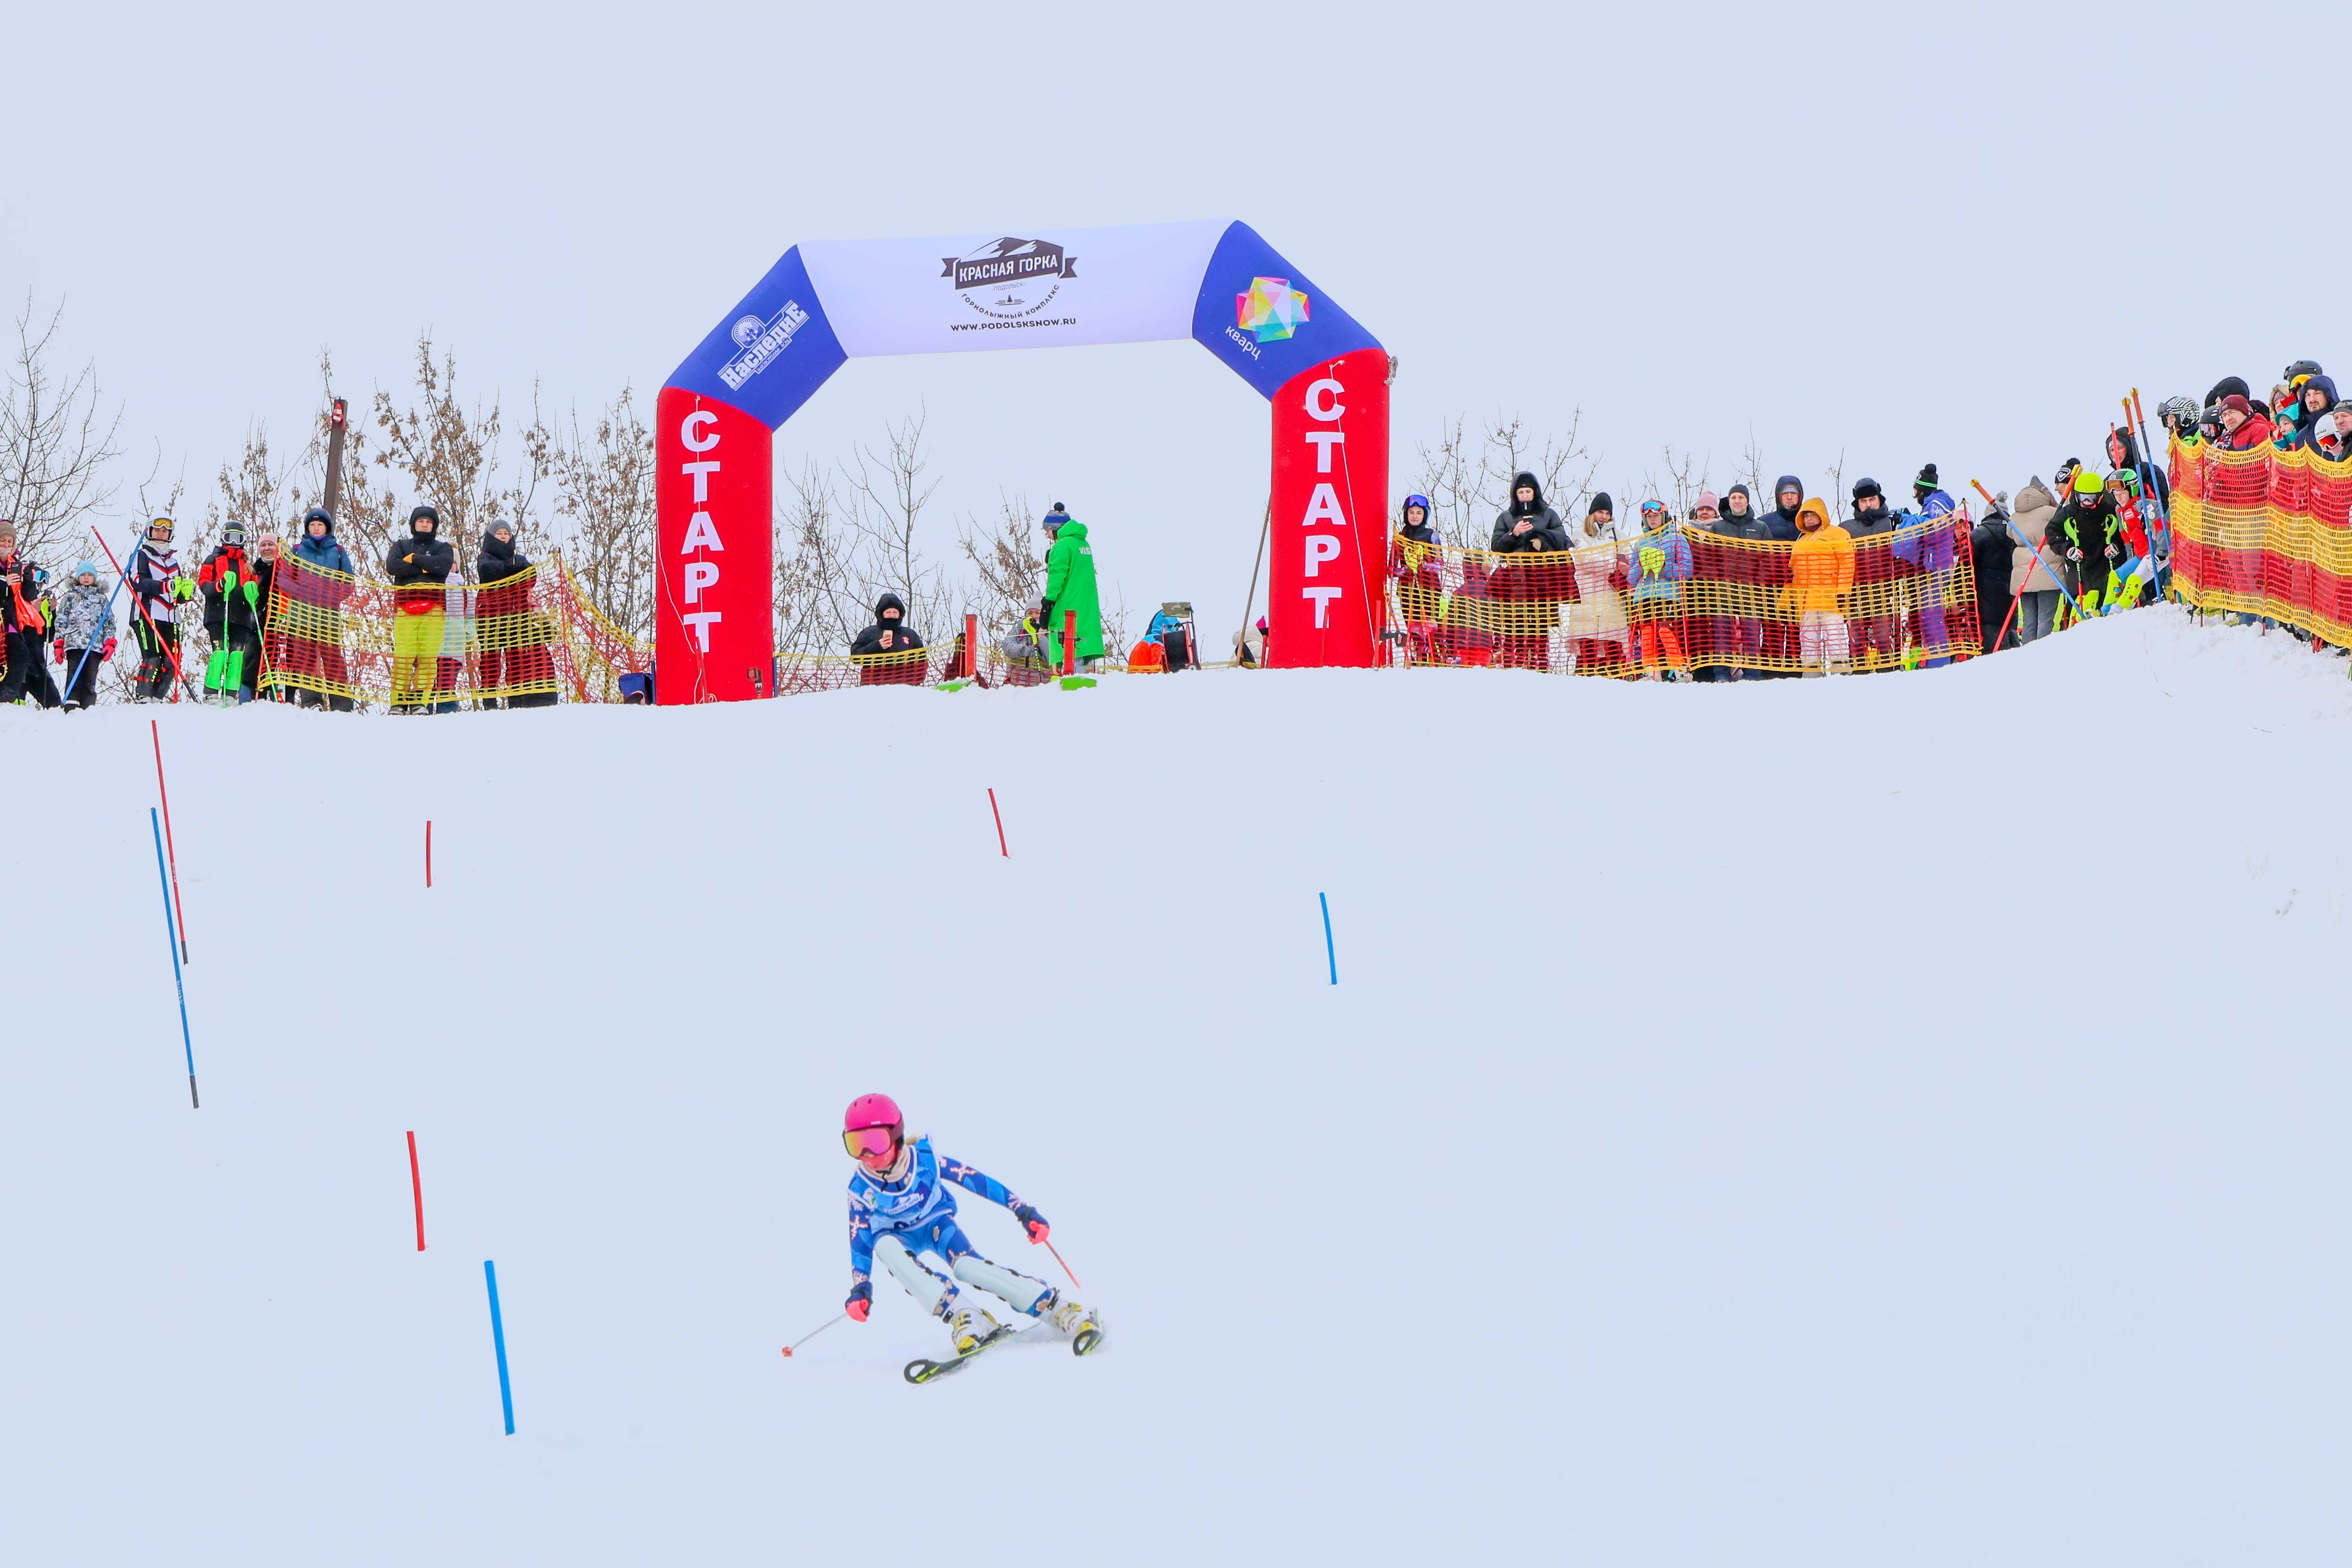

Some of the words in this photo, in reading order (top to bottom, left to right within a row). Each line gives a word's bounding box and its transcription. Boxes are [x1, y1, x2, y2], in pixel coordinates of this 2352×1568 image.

[959, 260, 1014, 282] КРАСНАЯ
[1019, 254, 1058, 273] ГОРКА
[961, 293, 1023, 319] ГОРНОЛЫЖНЫЙ
[1025, 284, 1059, 316] КОМПЛЕКС
[950, 318, 1076, 332] WWW.PODOLSKSNOW.RU
[1225, 326, 1261, 361] кварц
[1302, 378, 1346, 629] СТАРТ
[681, 410, 724, 653] СТАРТ
